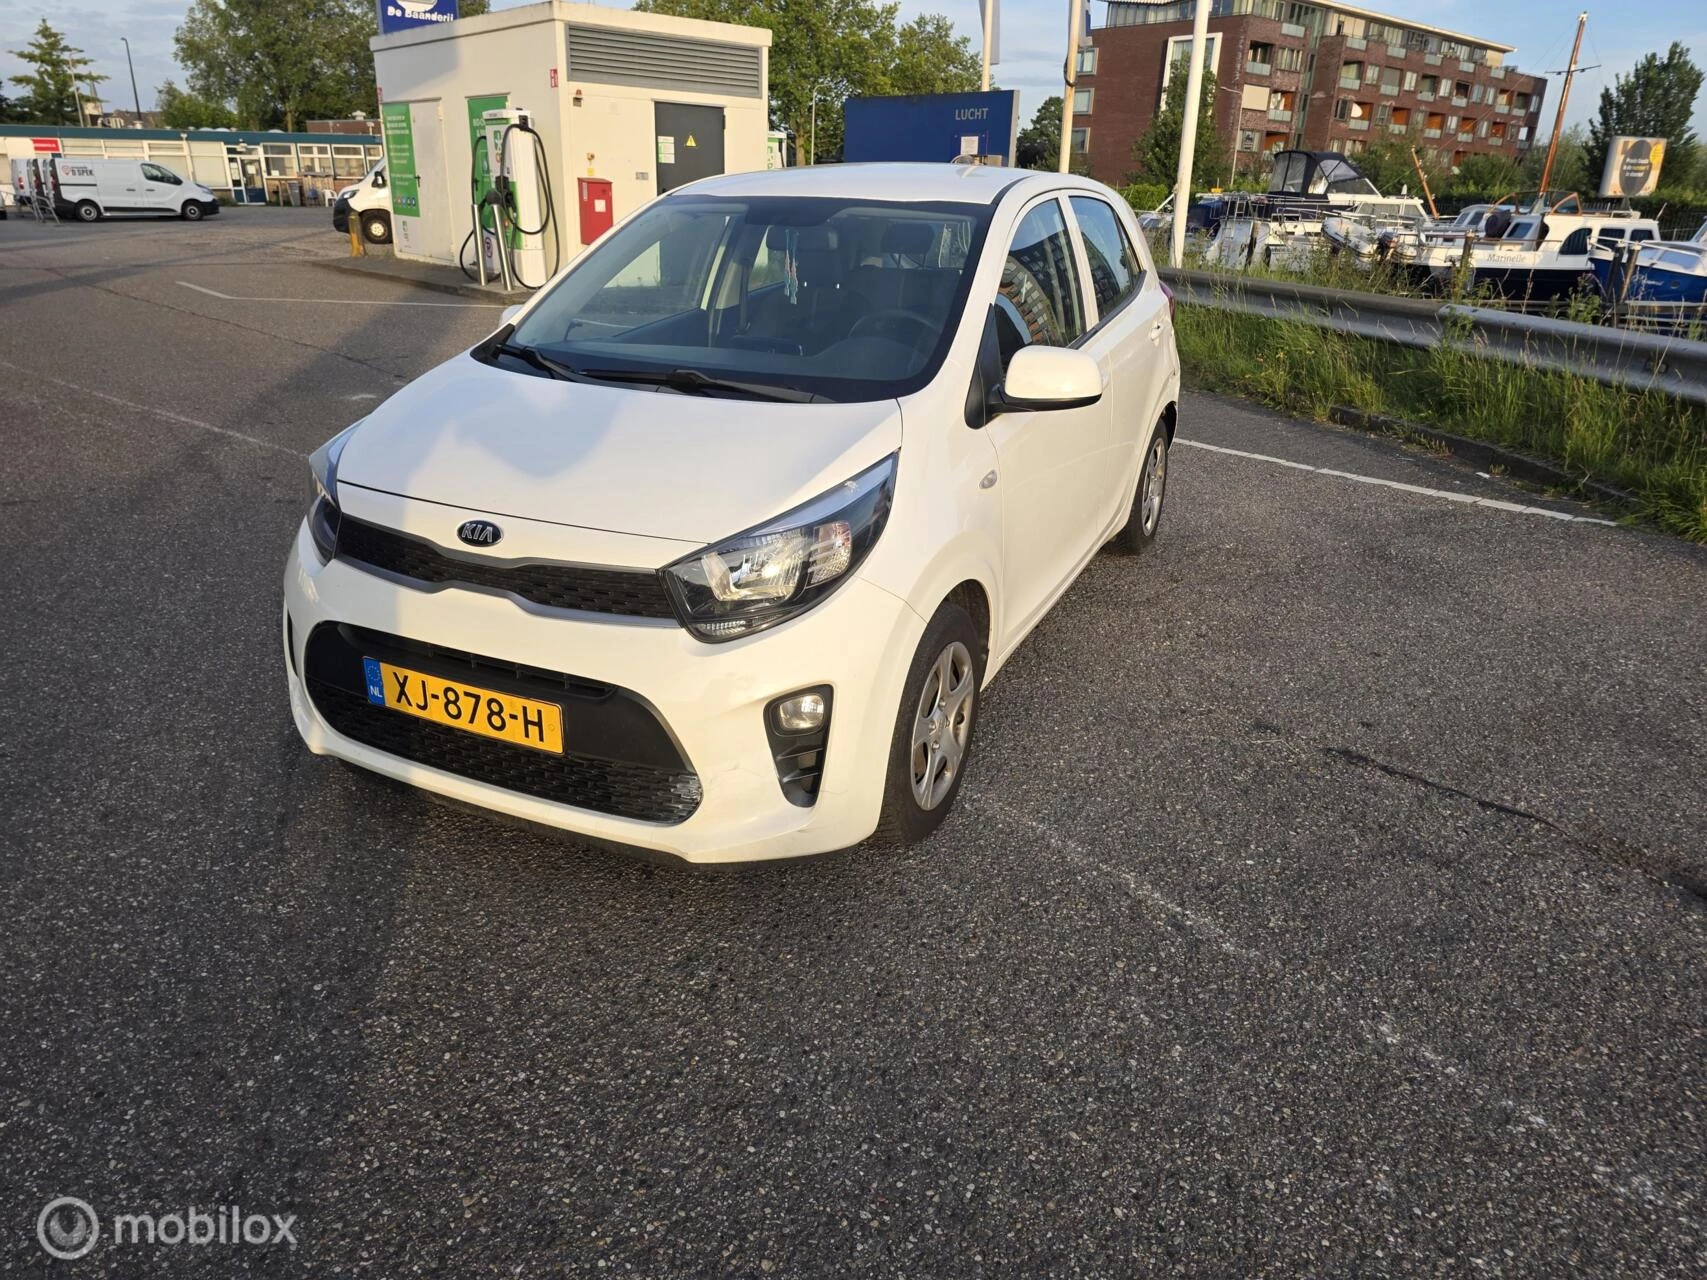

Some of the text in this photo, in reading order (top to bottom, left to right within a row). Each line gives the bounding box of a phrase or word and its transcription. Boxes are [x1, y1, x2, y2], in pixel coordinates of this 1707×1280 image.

[387, 5, 402, 17] De
[955, 108, 988, 120] LUCHT
[461, 523, 493, 543] KIA
[369, 685, 383, 698] NL
[392, 671, 545, 742] XJ-878-H
